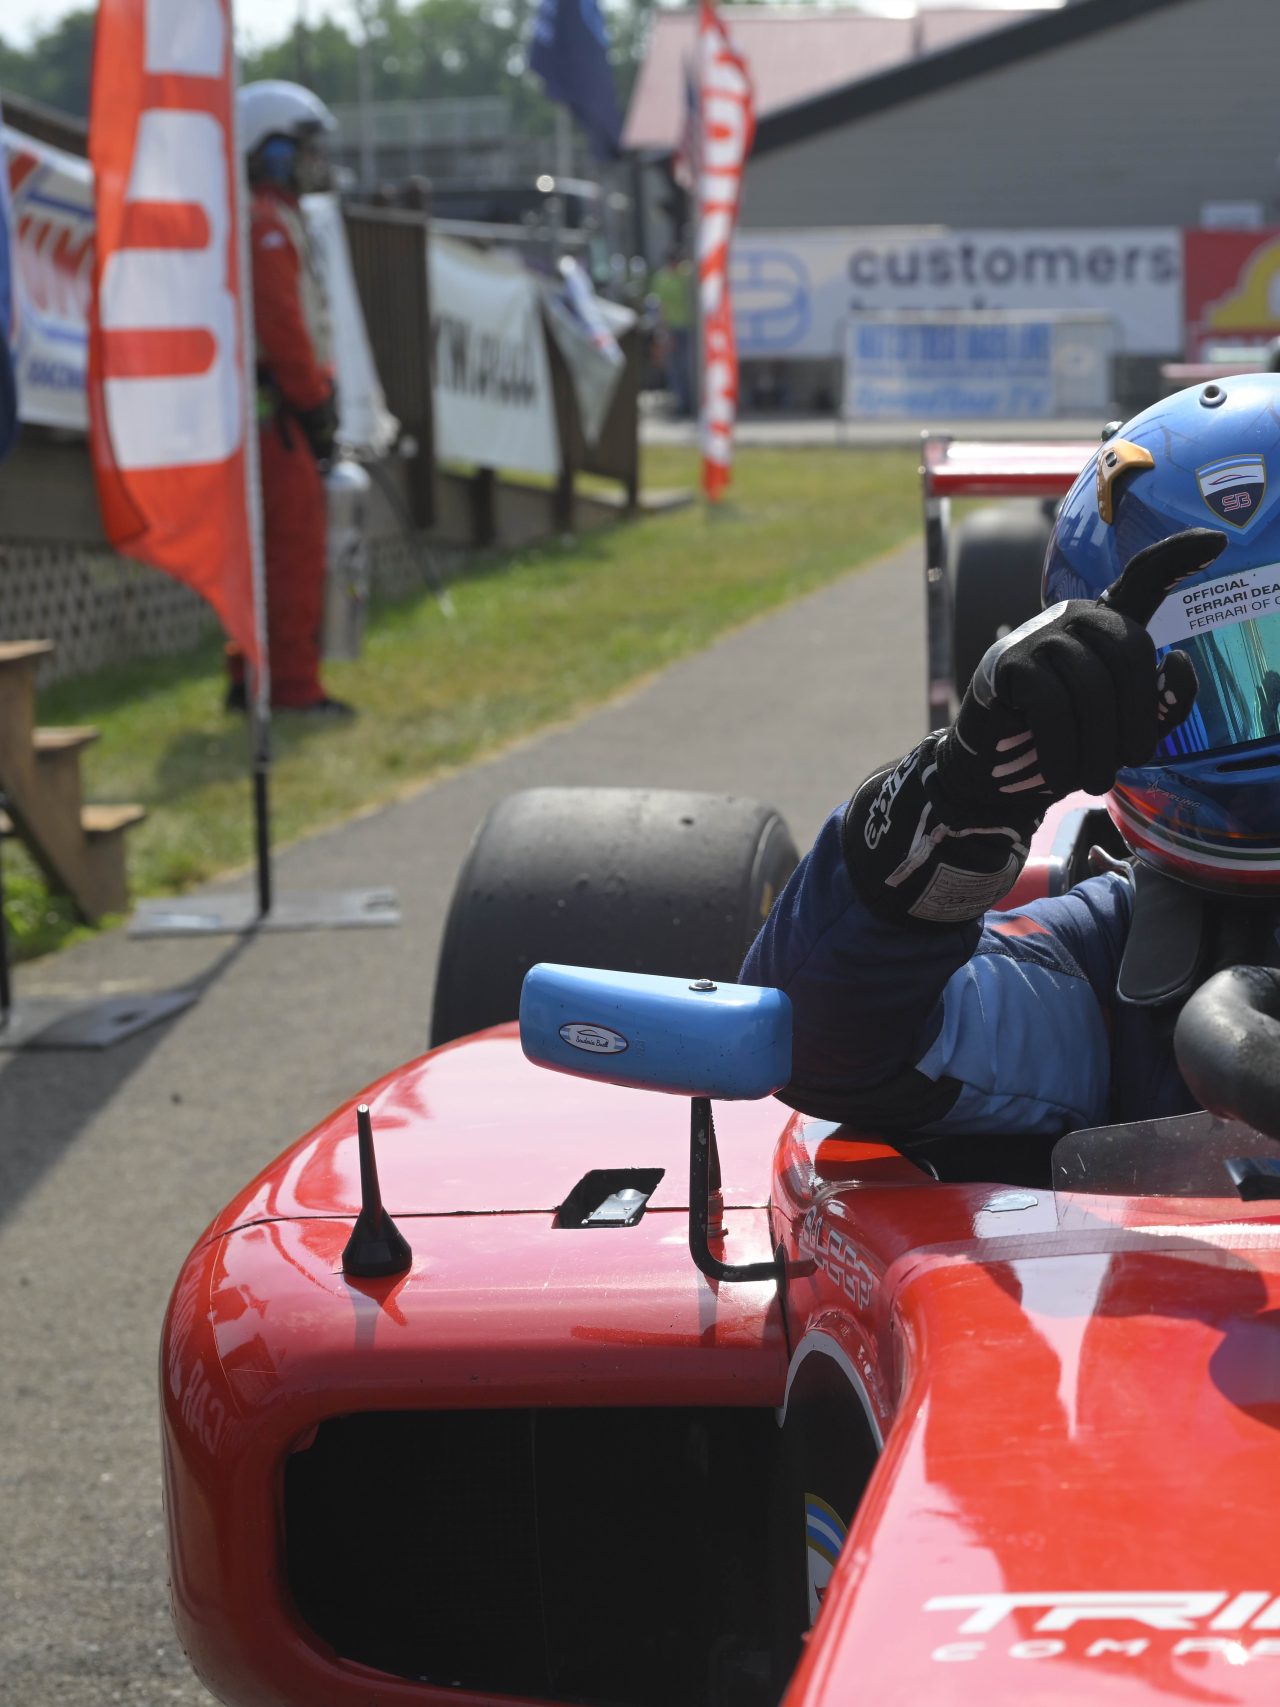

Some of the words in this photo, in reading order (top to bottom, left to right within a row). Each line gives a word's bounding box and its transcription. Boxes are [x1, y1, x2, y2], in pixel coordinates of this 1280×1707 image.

[849, 239, 1179, 288] customers
[1182, 579, 1250, 605] OFFICIAL
[1186, 591, 1248, 618] FERRARI
[1189, 605, 1248, 631] FERRARI
[1251, 598, 1271, 611] OF
